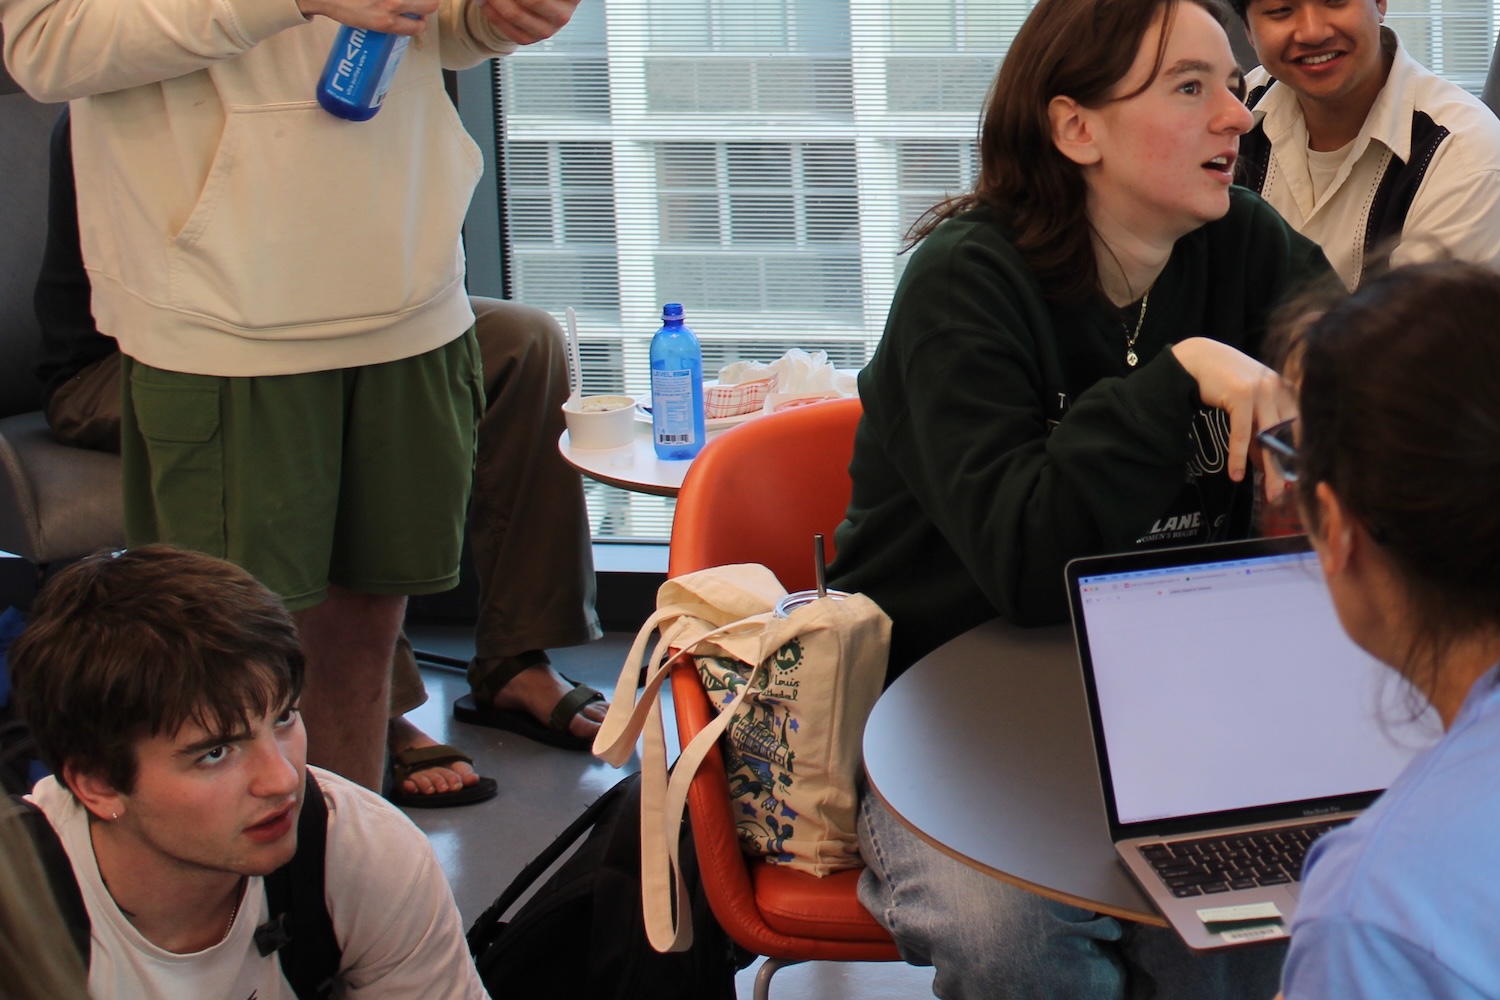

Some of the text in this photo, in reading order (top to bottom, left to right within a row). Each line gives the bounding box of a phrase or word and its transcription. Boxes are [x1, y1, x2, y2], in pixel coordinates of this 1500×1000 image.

[331, 28, 368, 92] LEVE
[1149, 511, 1201, 534] LANE
[1172, 529, 1199, 539] RUGBY
[776, 648, 796, 662] LA
[774, 675, 801, 687] Louis
